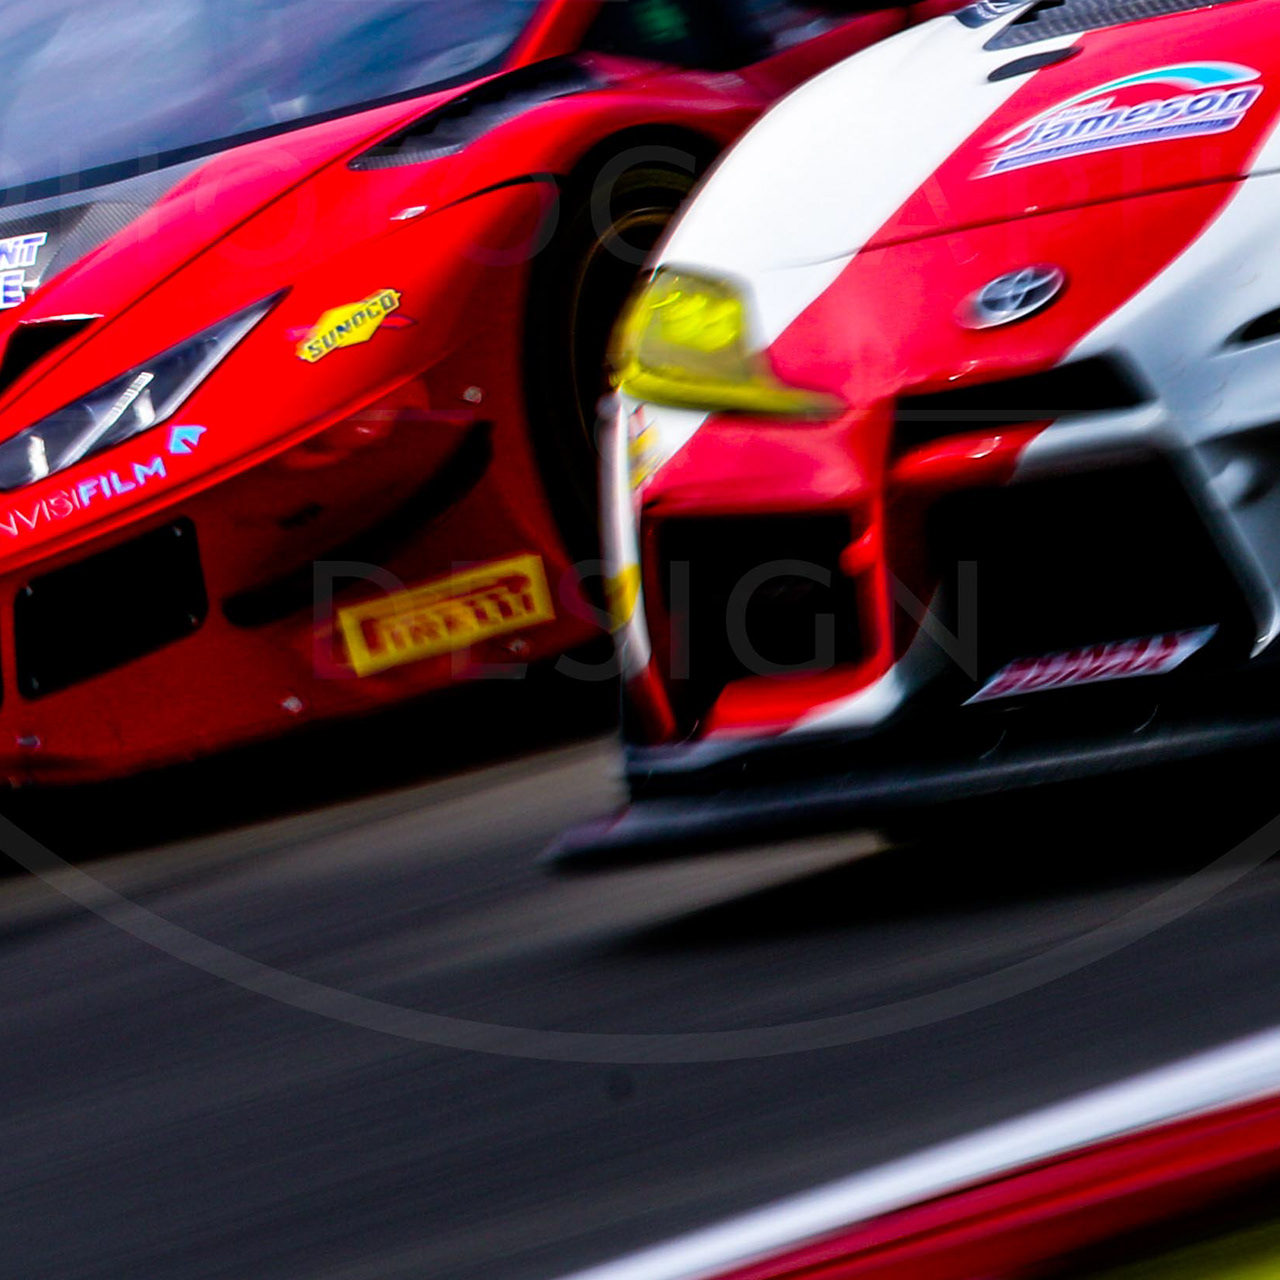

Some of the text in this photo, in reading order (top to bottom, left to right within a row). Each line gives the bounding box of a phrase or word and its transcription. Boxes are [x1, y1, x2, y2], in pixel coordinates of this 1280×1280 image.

[1005, 86, 1260, 153] Jameson
[308, 292, 398, 360] SUNOCO
[360, 573, 536, 658] PIRELLI
